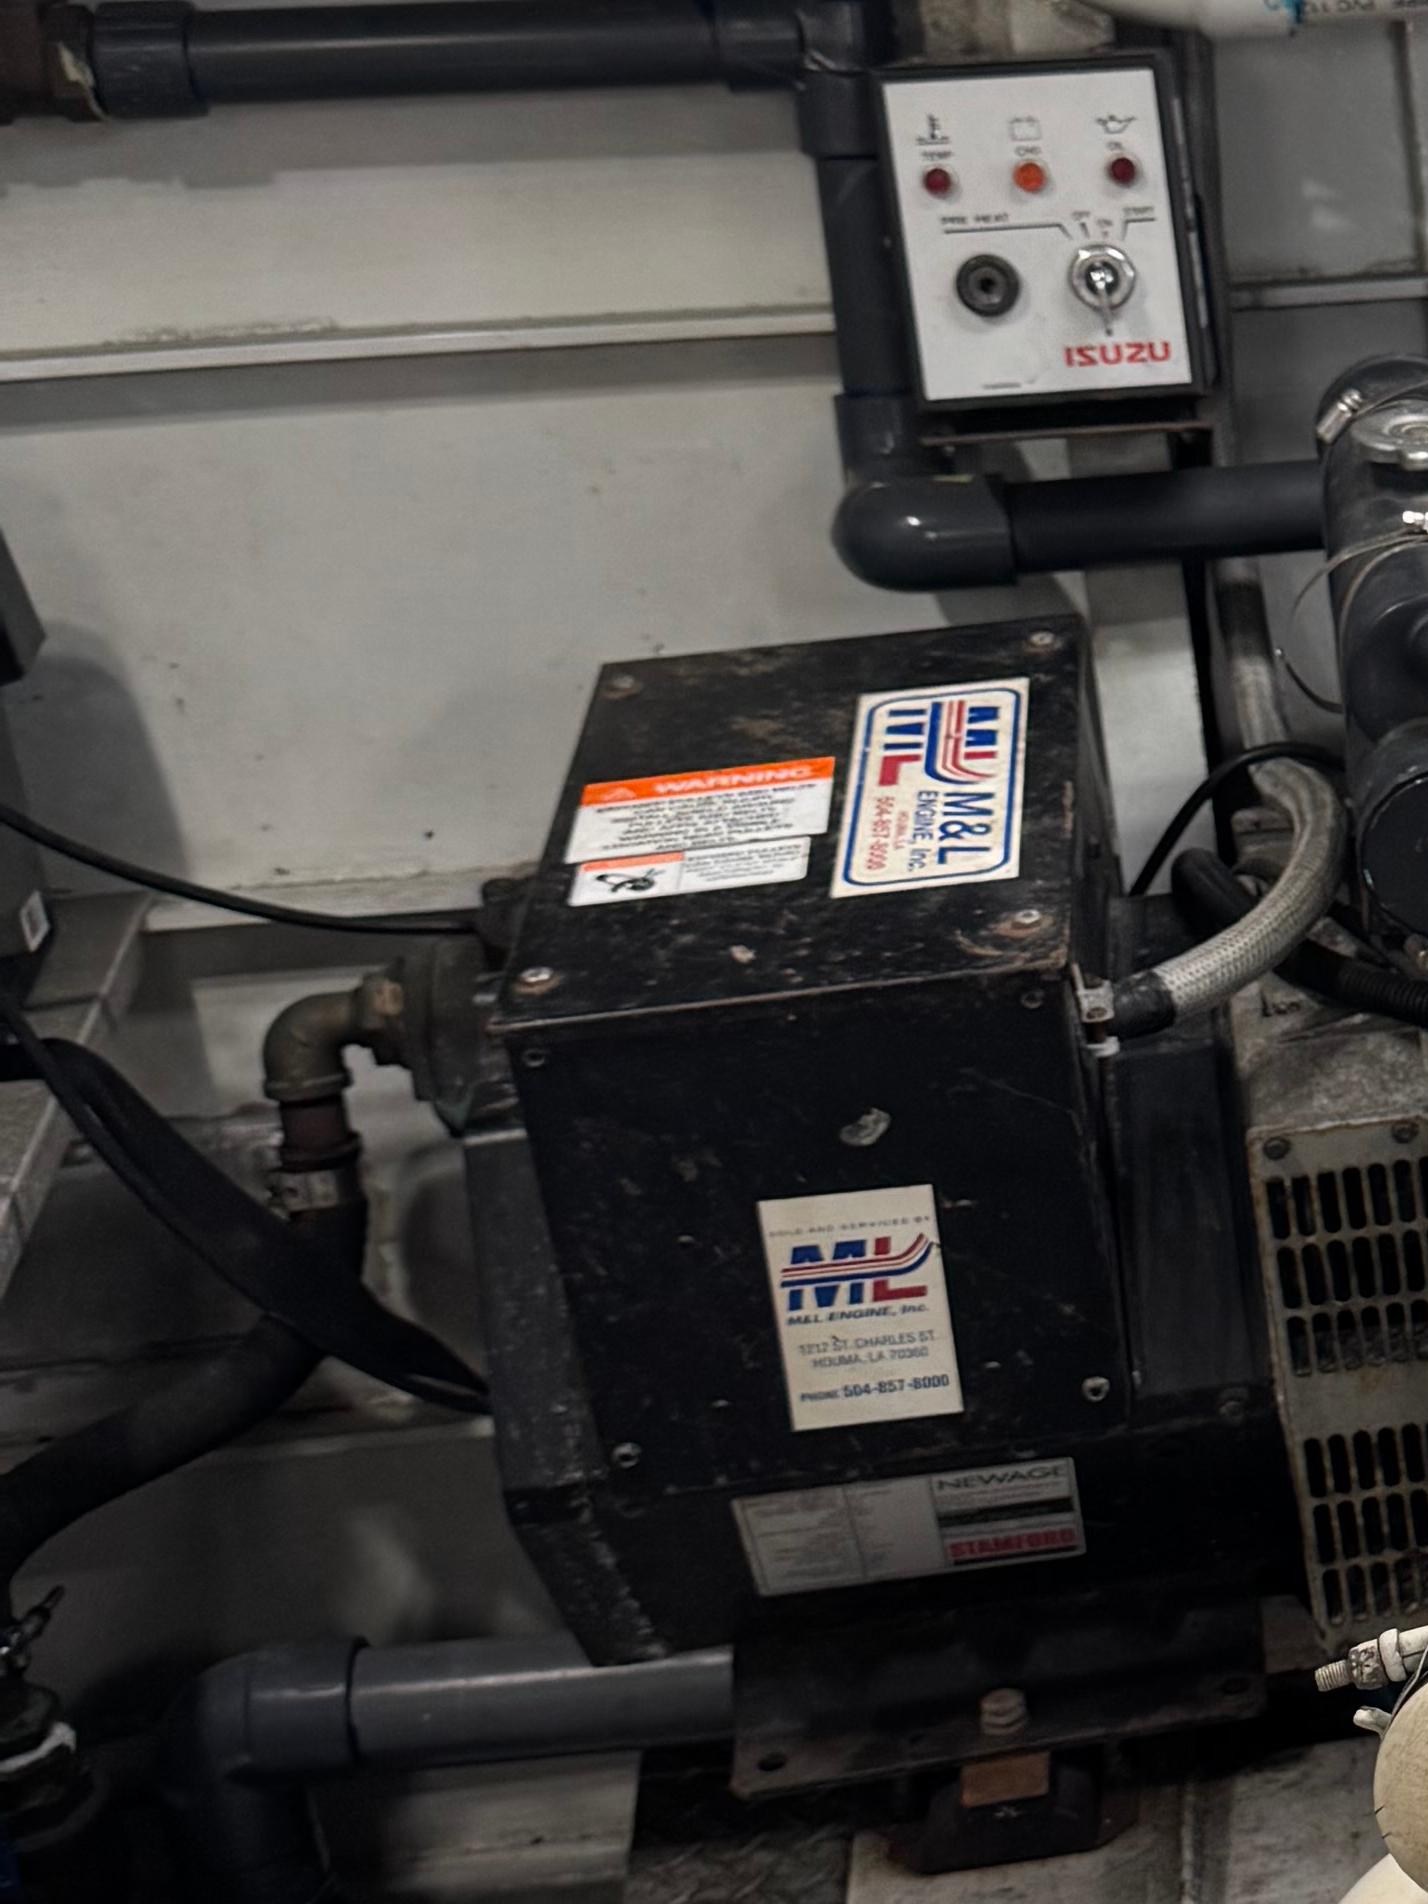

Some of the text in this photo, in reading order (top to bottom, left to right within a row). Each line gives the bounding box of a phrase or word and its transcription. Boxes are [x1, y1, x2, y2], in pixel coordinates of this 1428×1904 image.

[1063, 342, 1172, 368] ISUZU
[653, 764, 814, 794] WARNING
[936, 791, 995, 865] M&L
[829, 1306, 896, 1322] ENGINE,
[901, 1303, 929, 1314] Inc.
[854, 1333, 915, 1349] CHARLES
[843, 1373, 950, 1398] 504-857-8000
[936, 1465, 1066, 1491] NEWAGE
